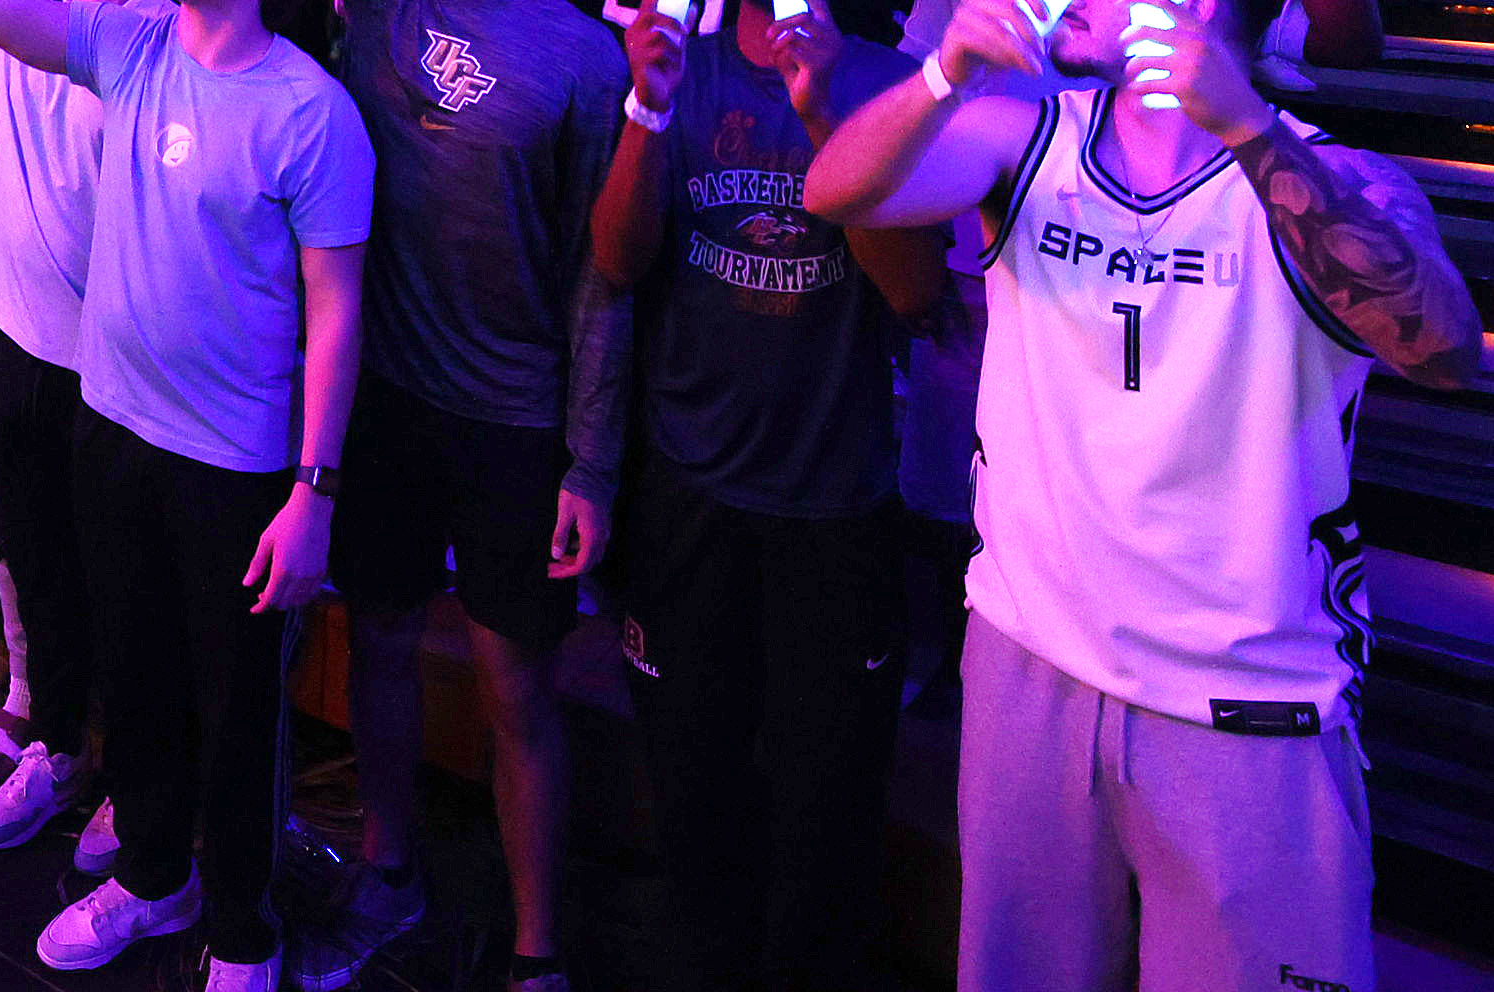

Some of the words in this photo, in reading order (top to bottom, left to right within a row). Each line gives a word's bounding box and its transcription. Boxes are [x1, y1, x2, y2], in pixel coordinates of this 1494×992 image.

[420, 28, 497, 113] UCF
[688, 230, 845, 293] TOURNAMENT
[1111, 301, 1142, 393] 1
